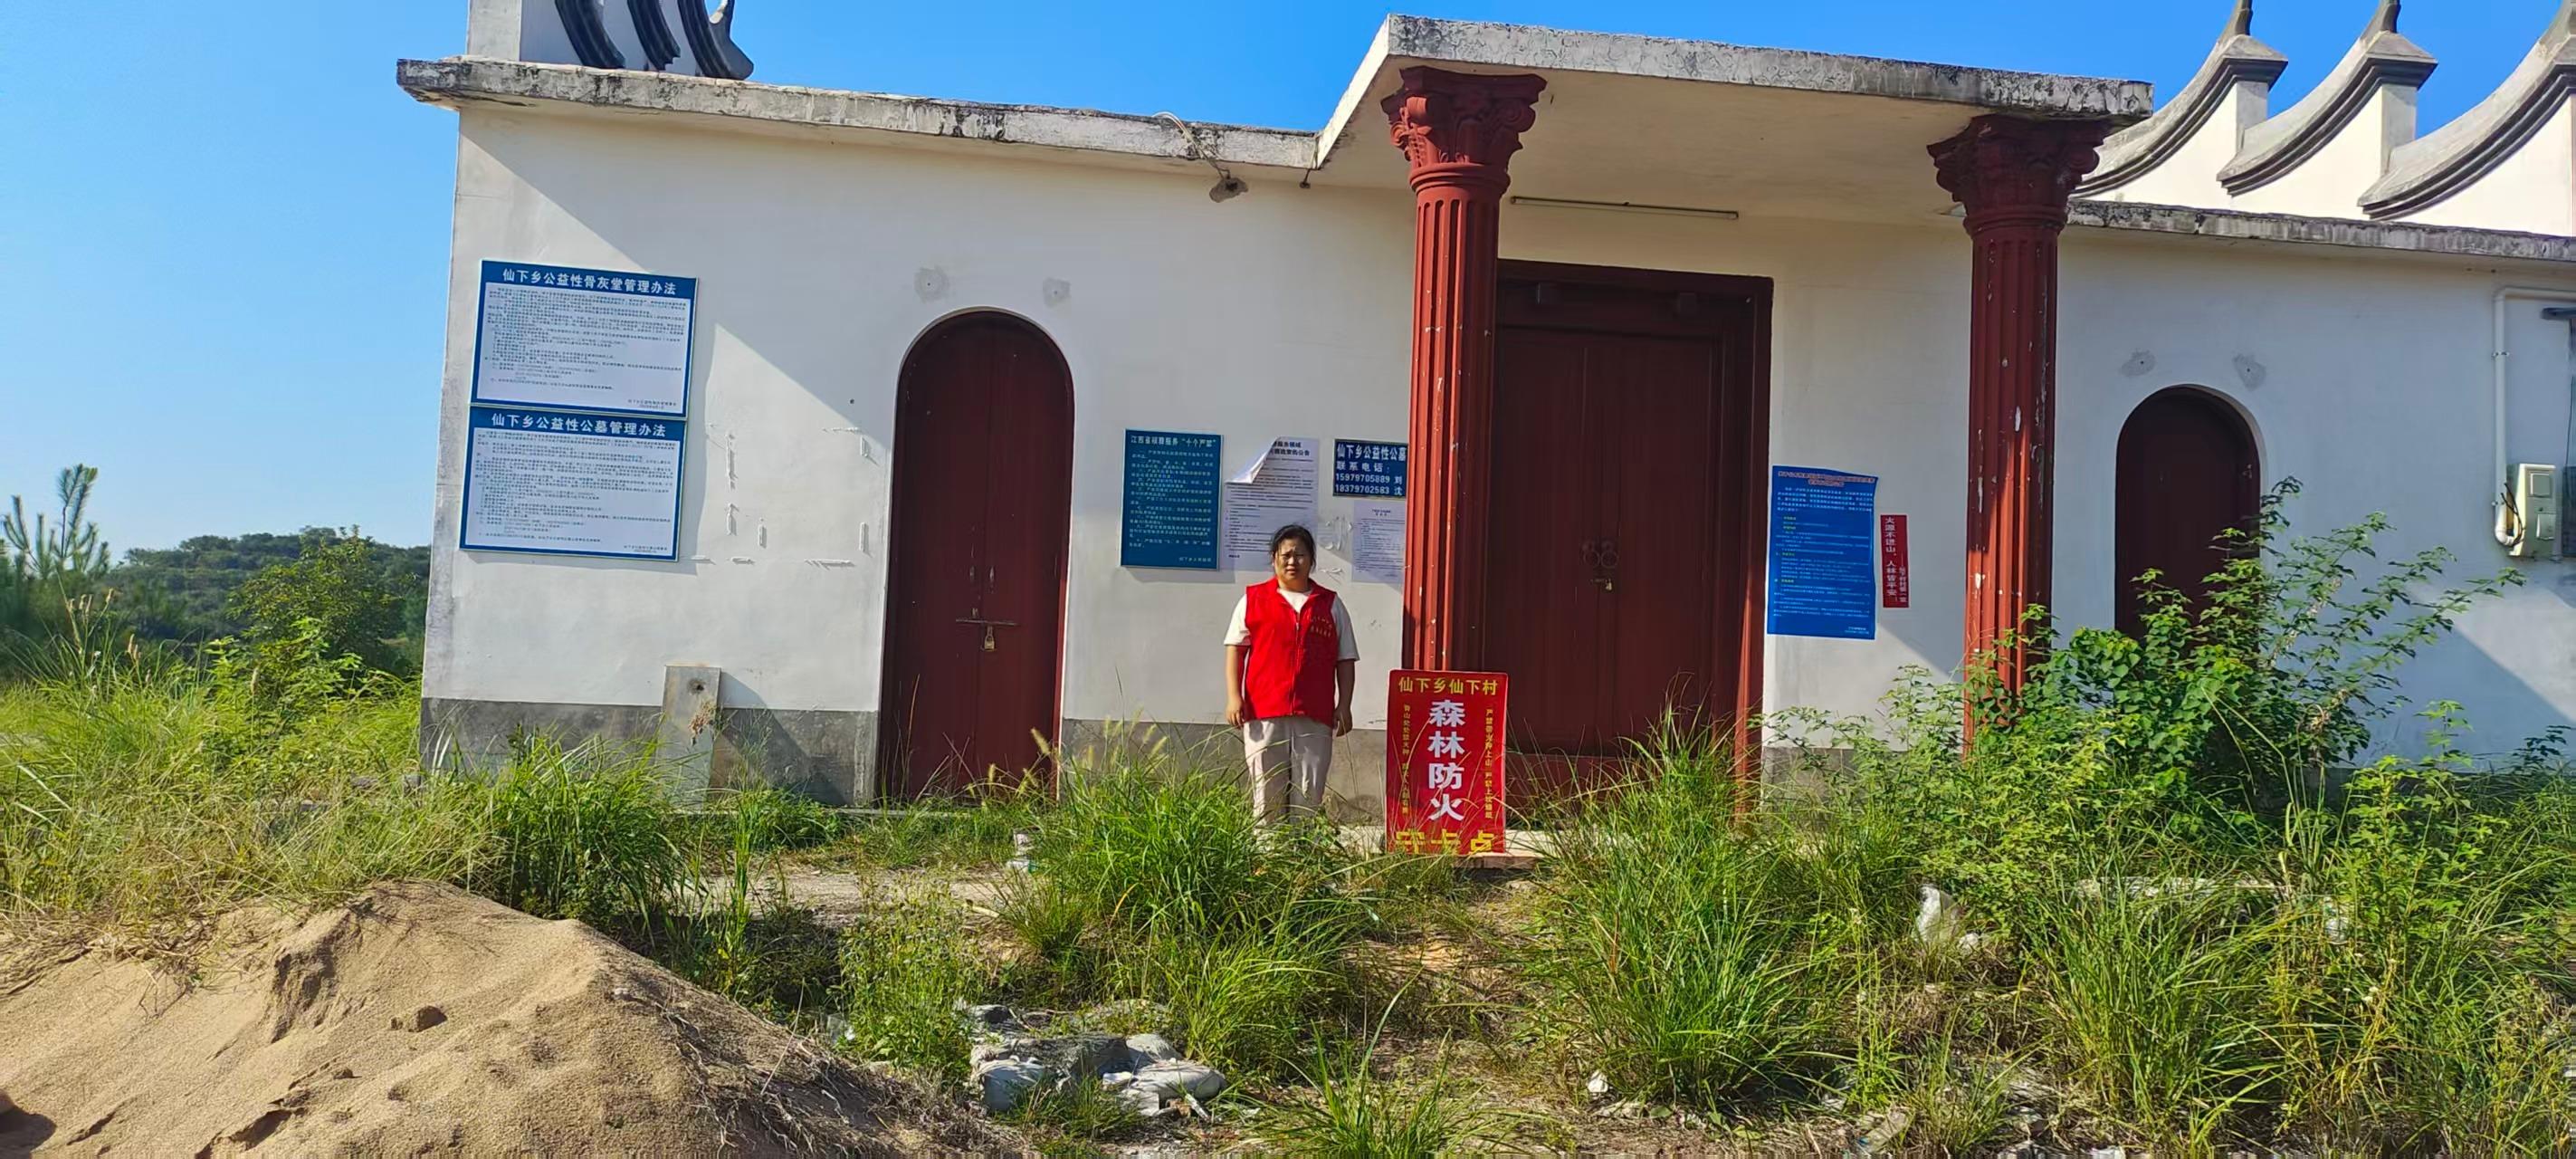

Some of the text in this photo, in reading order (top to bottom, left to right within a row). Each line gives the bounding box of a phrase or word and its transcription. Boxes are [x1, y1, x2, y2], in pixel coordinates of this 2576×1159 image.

[502, 268, 677, 295] 仙下乡公益性骨灰堂管理办法
[491, 413, 666, 437] 仙下乡公益性公墓管理办法
[1337, 443, 1407, 461] 仙下乡公益性公墓
[1335, 473, 1390, 484] 15979705889
[1335, 484, 1389, 494] 18379702583
[1398, 676, 1498, 695] 仙下乡仙下村
[1427, 699, 1465, 821] 森林防火
